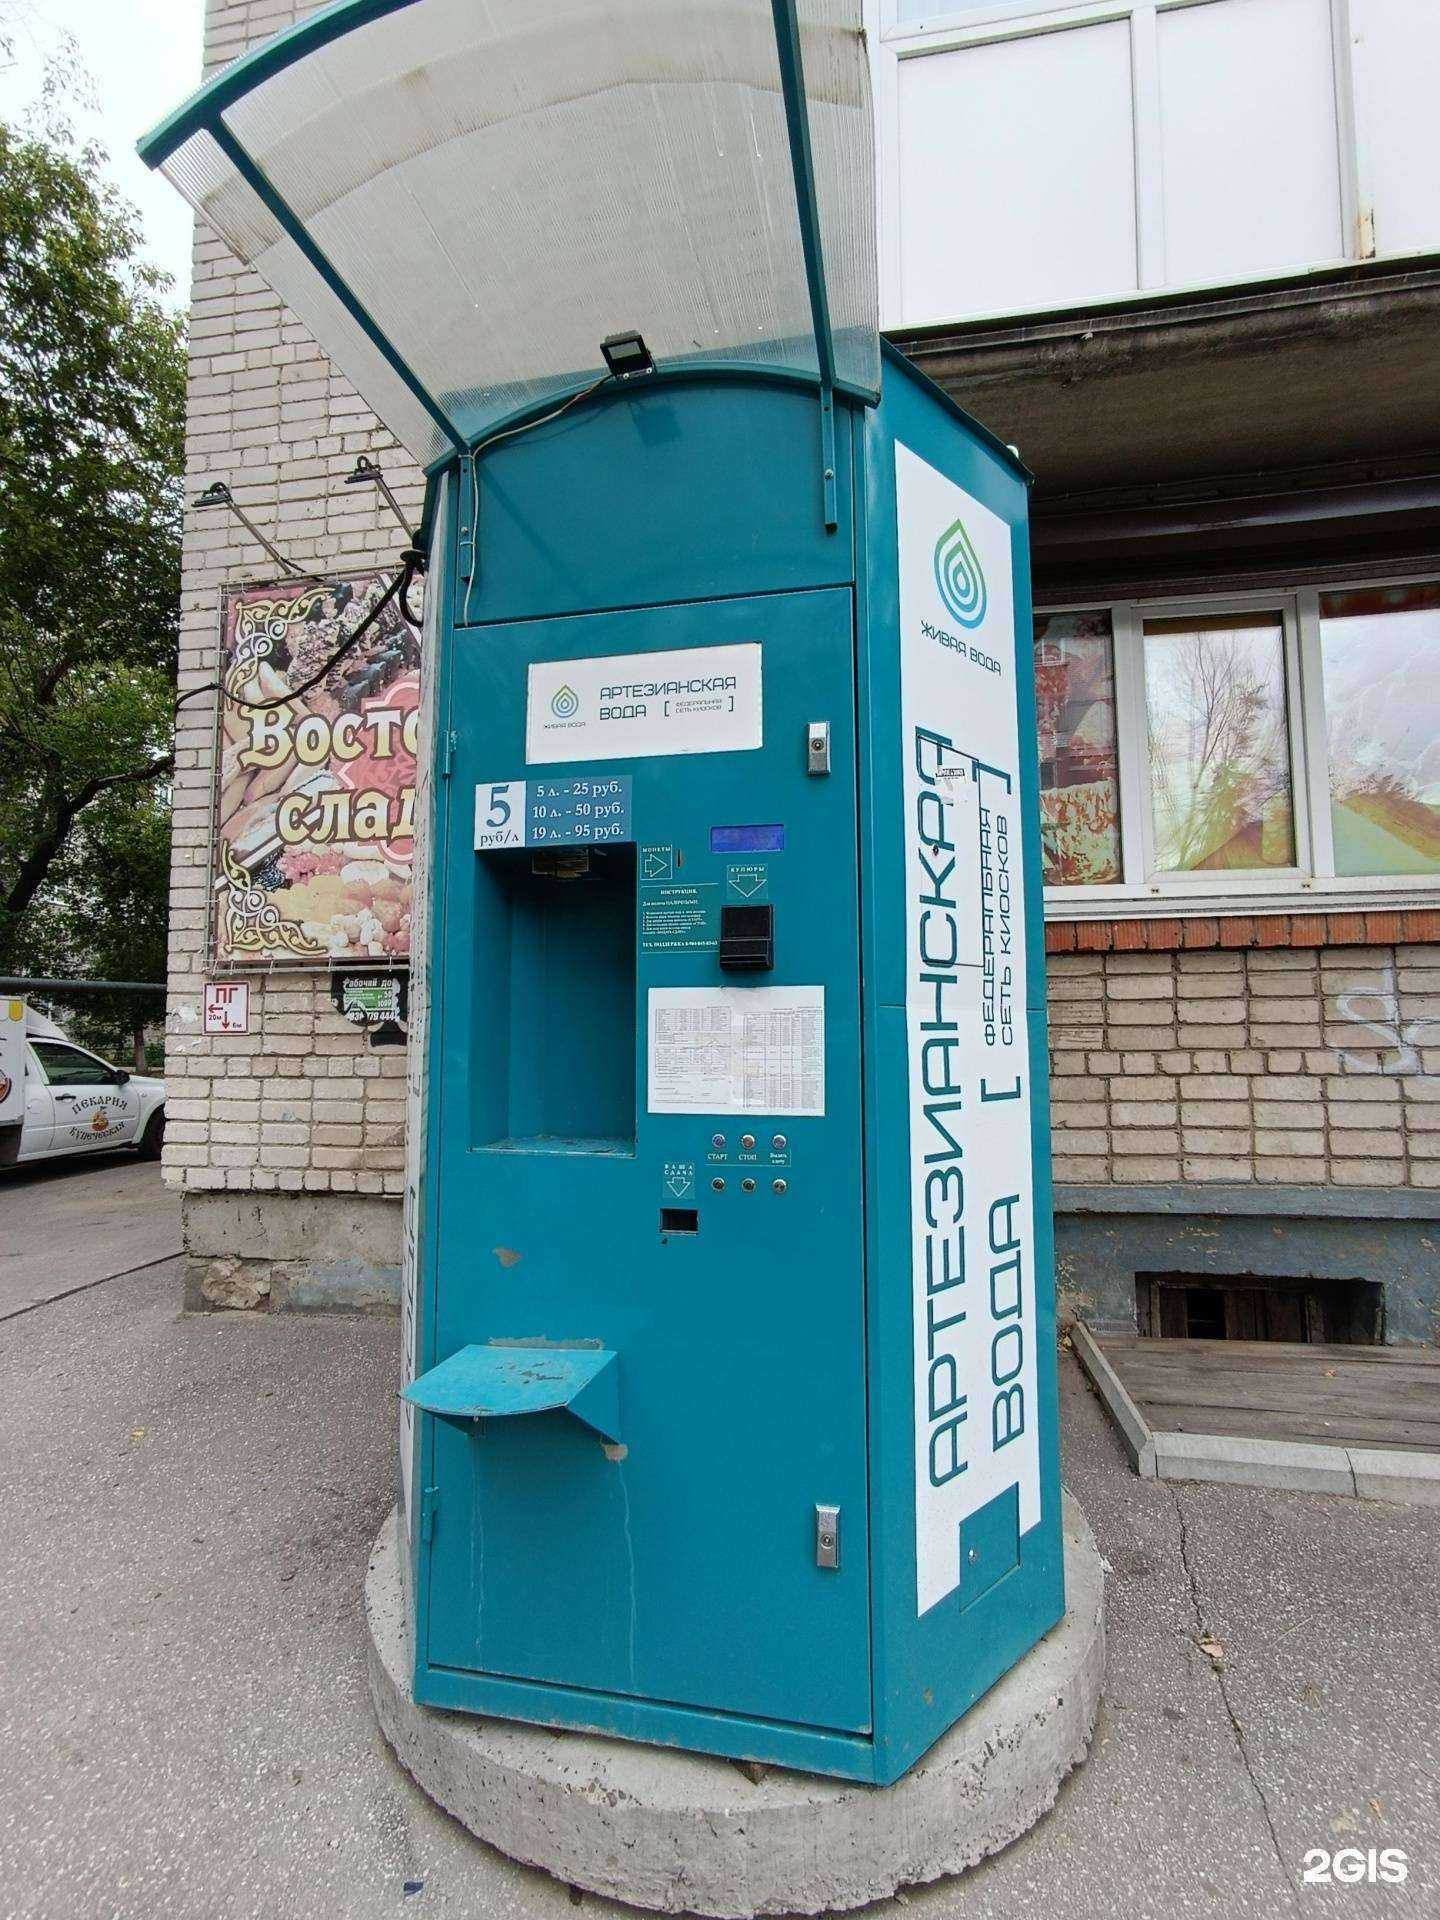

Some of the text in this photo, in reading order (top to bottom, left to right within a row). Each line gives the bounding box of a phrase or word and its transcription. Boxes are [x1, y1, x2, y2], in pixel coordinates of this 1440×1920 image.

[921, 620, 1002, 676] ЖИВАЯ ВОДА
[599, 675, 737, 701] АРТЕЗИАНСКАЯ
[599, 704, 647, 721] ВОДА
[536, 785, 545, 797] 5
[573, 782, 589, 795] 25
[592, 781, 623, 798] руб.
[486, 784, 511, 827] 5
[532, 806, 547, 818] 10
[574, 803, 591, 815] 50
[594, 802, 625, 819] руб.
[480, 829, 520, 847] руб/л
[532, 827, 547, 840] 19
[574, 824, 591, 837] 95
[593, 822, 625, 840] руб.
[980, 808, 996, 1047] ФЕДЕРАЛЬНАЯ
[997, 814, 1014, 1047] СЕТЬ КИОСКОВ
[216, 987, 239, 1004] ПГ
[72, 1096, 128, 1115] ПЕКАРНЯ
[915, 725, 968, 1488] АРТЕЗИАНСКАЯ
[707, 1153, 728, 1161] СТАРТ
[988, 1193, 1025, 1453] ВОДА
